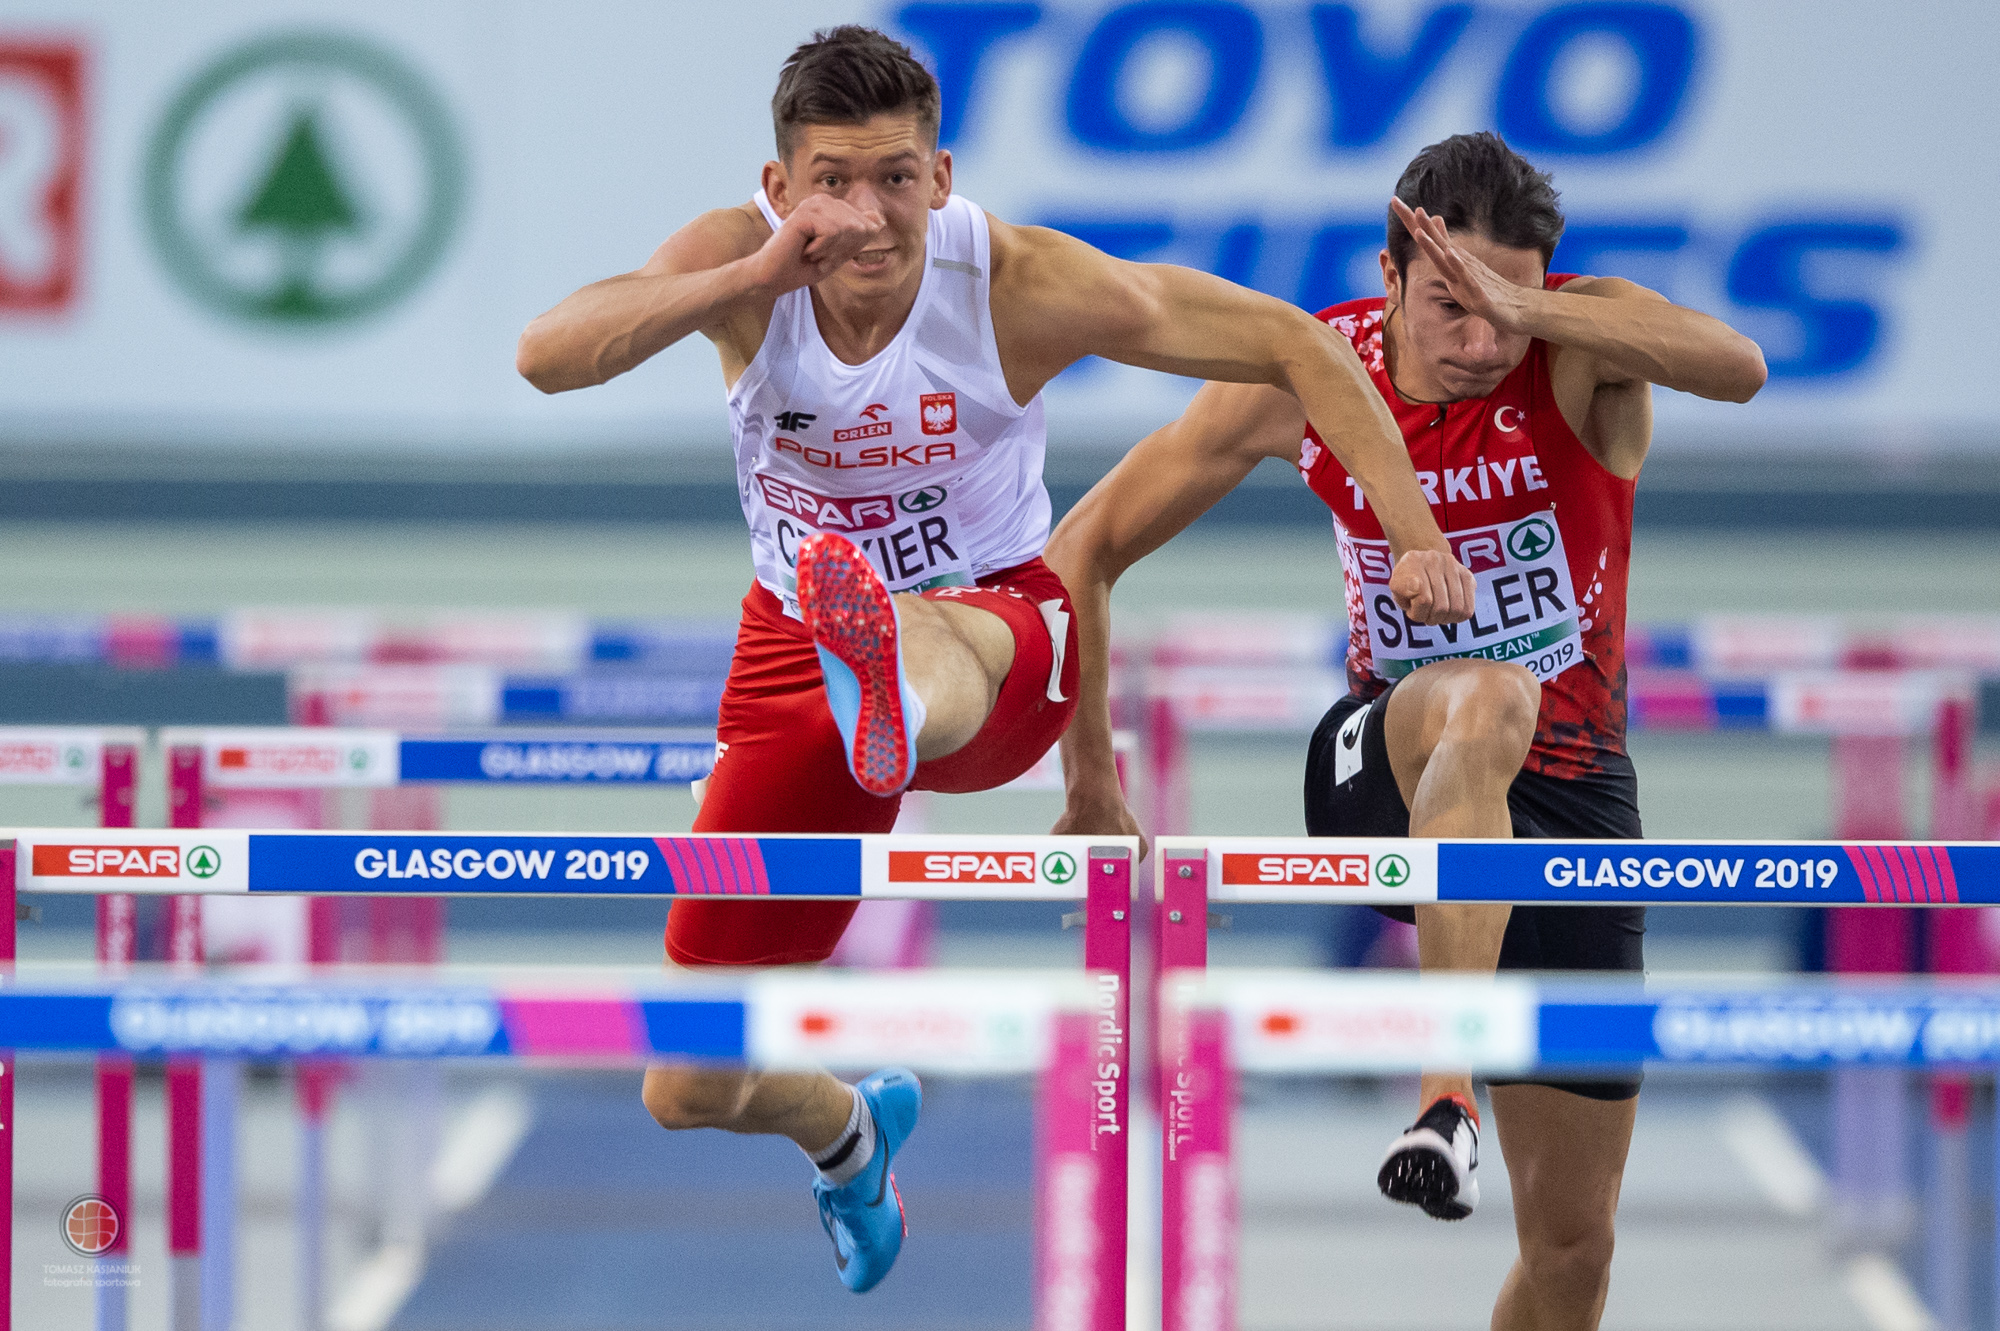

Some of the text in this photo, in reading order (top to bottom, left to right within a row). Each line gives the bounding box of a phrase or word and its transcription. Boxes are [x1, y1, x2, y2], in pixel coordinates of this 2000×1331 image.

[894, 0, 1698, 150] TOYO
[836, 424, 888, 441] ORLEN
[775, 437, 957, 470] POLSKA
[1345, 456, 1549, 510] TRKİYE
[762, 478, 891, 529] SPAR
[777, 516, 959, 582] CIER
[1359, 537, 1500, 580] SR
[1525, 642, 1574, 677] 2019
[68, 849, 179, 874] SPAR
[354, 848, 650, 881] GLASGOW 2019
[924, 855, 1034, 880] SPAR
[1257, 858, 1368, 883] SPAR
[1544, 857, 1839, 889] GLASGOW 2019
[1091, 974, 1123, 1135] nordic Sport
